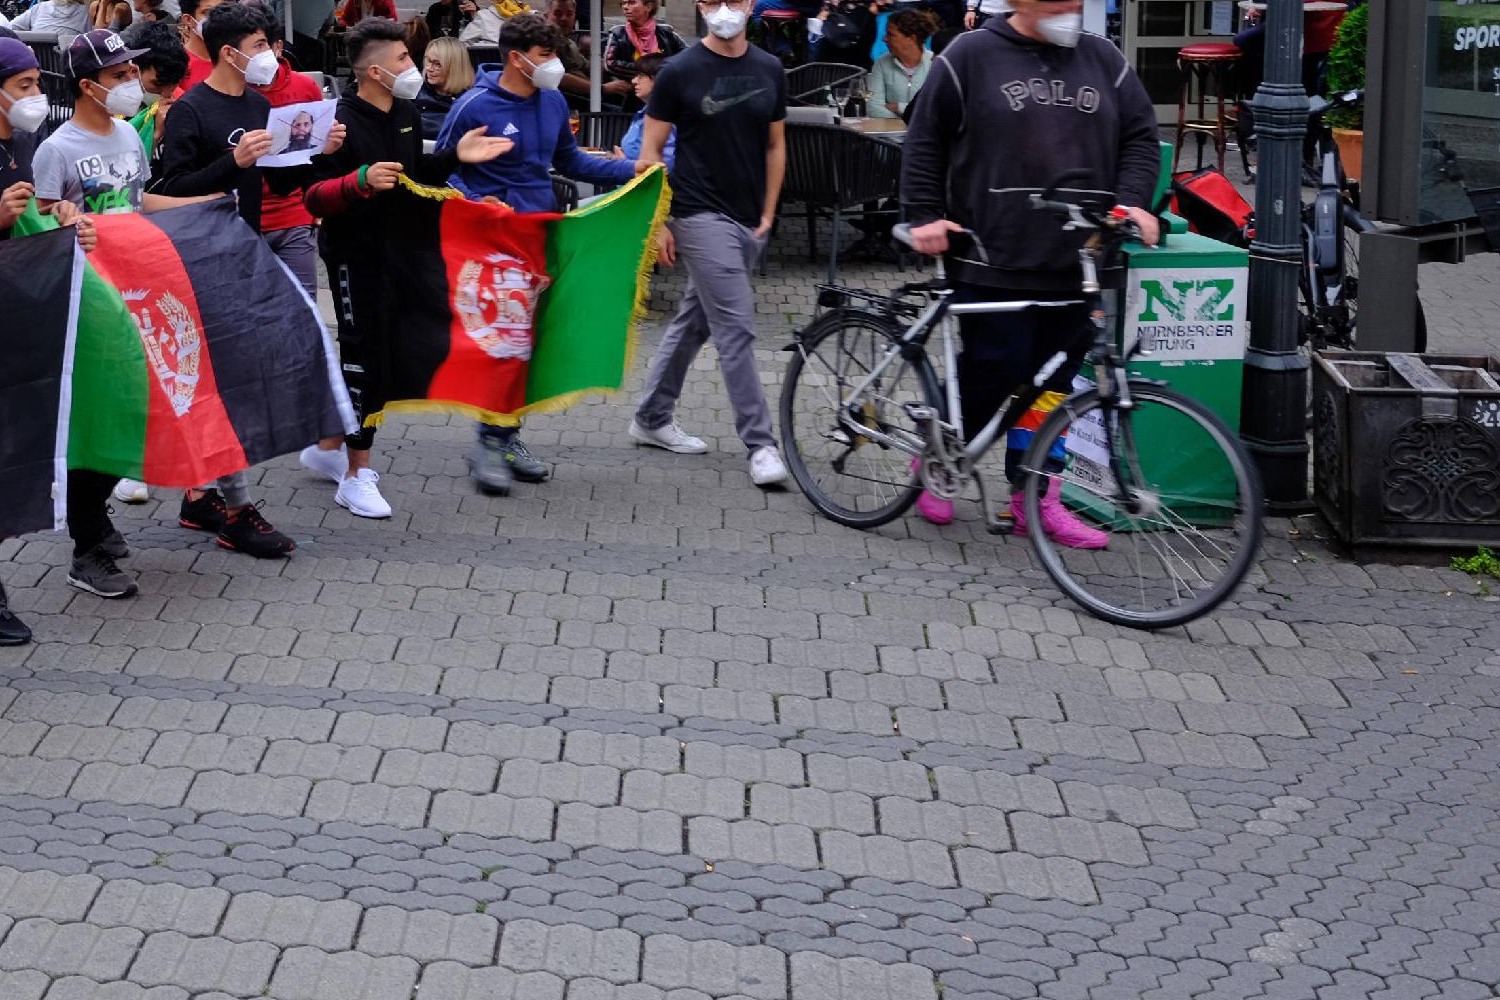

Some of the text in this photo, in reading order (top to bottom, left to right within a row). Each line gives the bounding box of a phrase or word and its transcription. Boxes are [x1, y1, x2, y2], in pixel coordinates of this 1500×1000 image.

[1453, 24, 1500, 51] SPOR
[1000, 78, 1100, 114] POLO
[80, 157, 102, 178] 09
[1138, 278, 1235, 322] NZ
[1149, 338, 1195, 351] EITUNG
